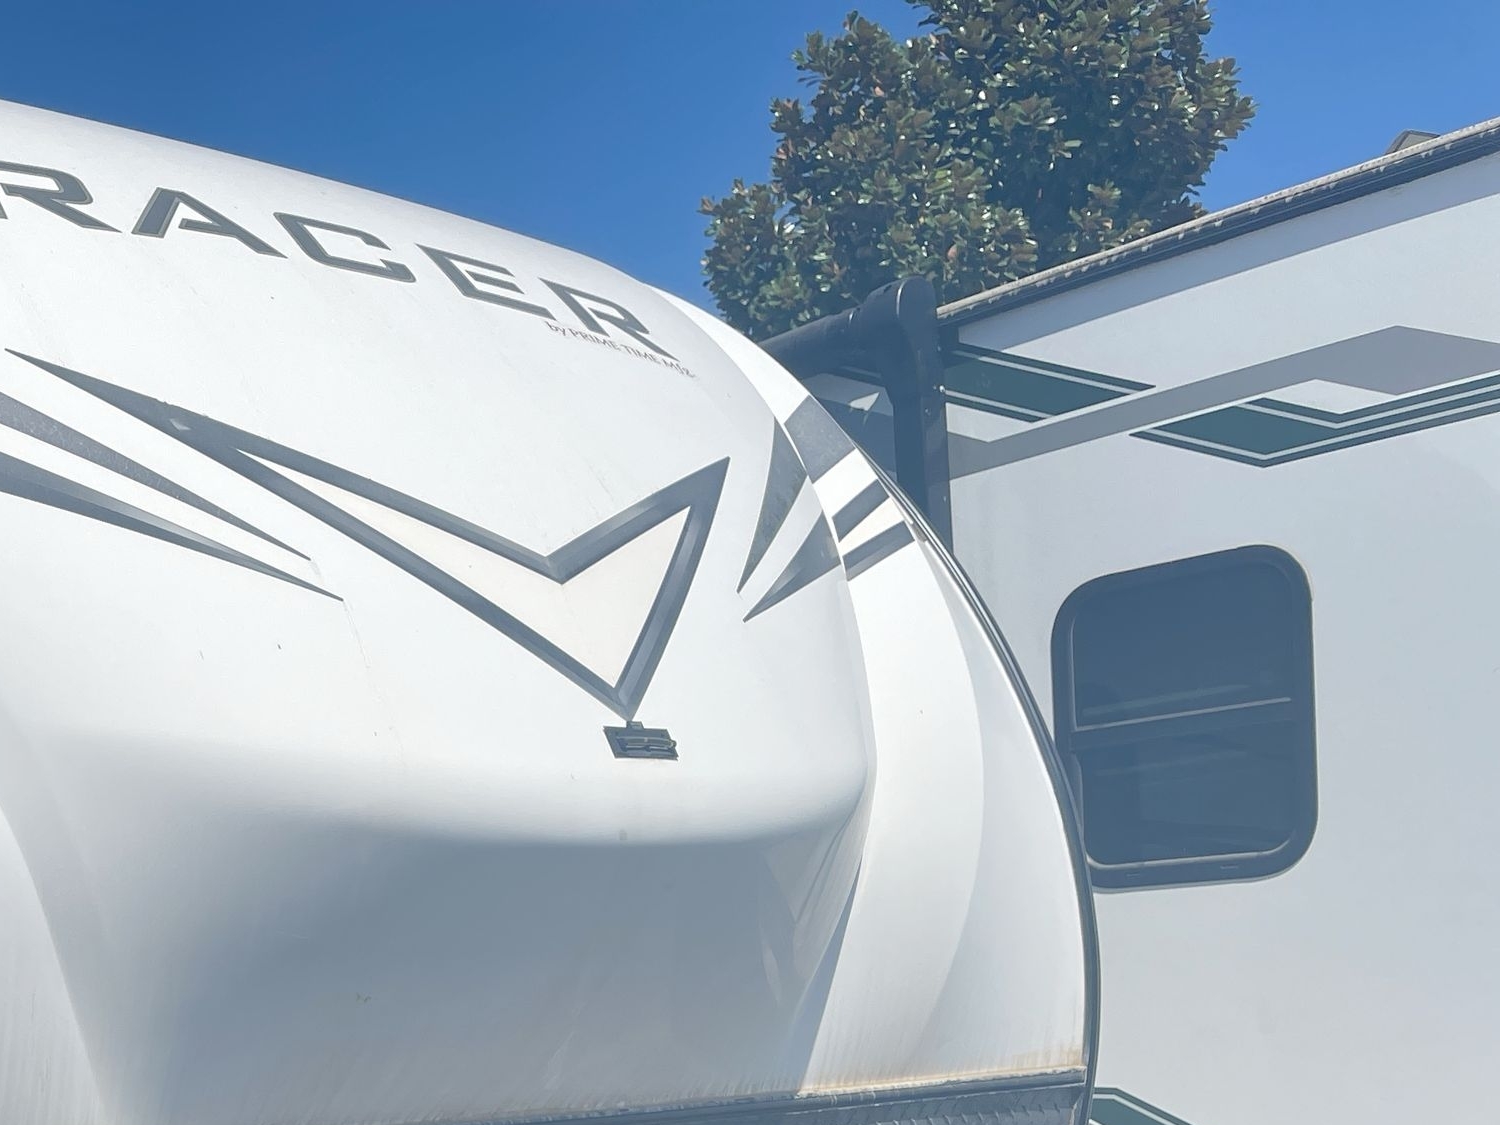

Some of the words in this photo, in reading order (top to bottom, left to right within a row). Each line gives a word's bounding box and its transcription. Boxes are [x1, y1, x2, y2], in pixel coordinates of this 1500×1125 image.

[545, 321, 567, 337] by
[568, 328, 620, 352] PRIME
[619, 344, 661, 365] TIME
